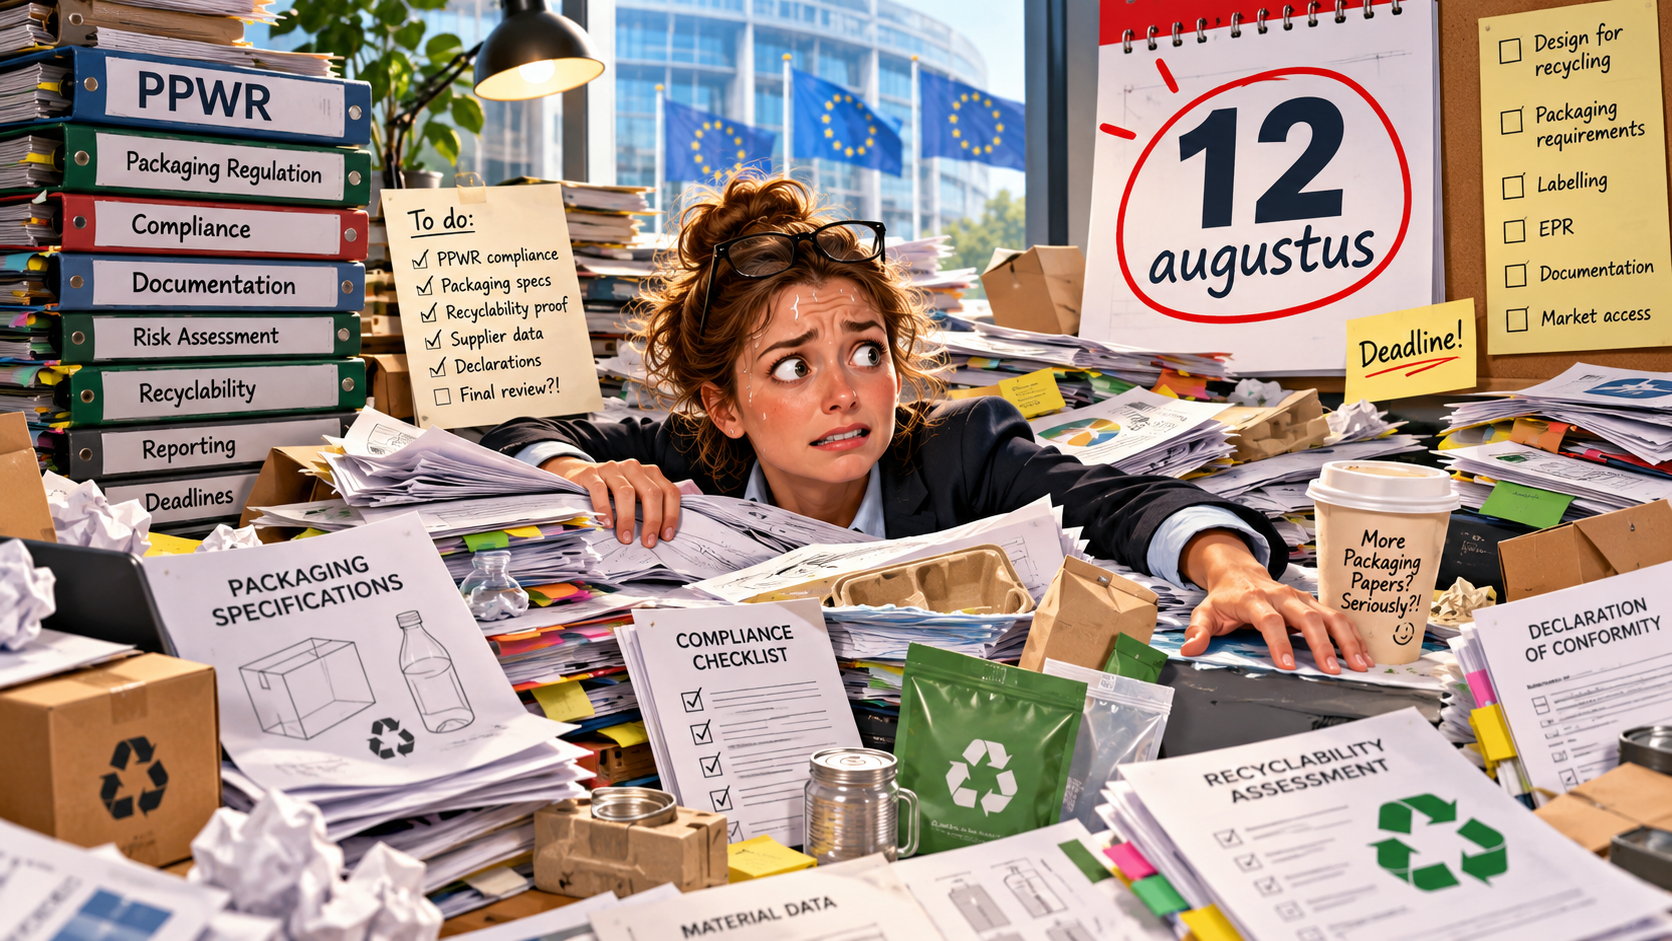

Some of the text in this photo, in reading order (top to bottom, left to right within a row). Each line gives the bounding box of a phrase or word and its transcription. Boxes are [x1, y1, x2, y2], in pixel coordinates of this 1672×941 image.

[1535, 23, 1623, 53] Design for
[1536, 52, 1610, 79] recycling
[139, 71, 271, 121] PPWR
[1536, 101, 1617, 123] Packaging
[1537, 121, 1645, 151] requirements
[127, 151, 321, 185] Packaging Regulation
[1179, 97, 1344, 228] 12
[1538, 171, 1607, 192] Labelling
[132, 214, 250, 243] Compliance
[407, 207, 473, 230] To do:
[1540, 218, 1573, 237] EPR
[438, 248, 558, 267] PPWR compliance
[1149, 225, 1374, 298] augustus
[1541, 259, 1653, 281] Documentation
[133, 272, 295, 294] Documentation
[442, 277, 551, 295] Packaging specs
[446, 296, 568, 323] Recyclability proof
[1542, 308, 1650, 326] Market access
[134, 327, 279, 346] Risk Assessment
[451, 327, 543, 350] Supplier data
[1359, 320, 1462, 367] Deadline!
[455, 356, 541, 374] Declarations
[140, 378, 256, 407] Recyclability
[460, 377, 559, 402] Final review?!
[143, 436, 235, 463] Reporting
[146, 488, 233, 512] Deadlines
[1361, 530, 1405, 549] More
[1344, 548, 1421, 576] Packaging
[228, 555, 370, 597] PACKAGING
[1351, 572, 1414, 597] Papers?
[212, 573, 403, 626] SPECIFICATIONS
[1341, 592, 1421, 619] Seriously?!
[1528, 597, 1648, 640] DECLARATION
[677, 625, 793, 648] COMPLIANCE
[1526, 615, 1661, 662] OF CONFORMITY
[693, 647, 786, 670] CHECKLIST
[1203, 738, 1386, 788] RECYCLABILITY
[1231, 758, 1389, 803] ASSESSMENT
[681, 896, 837, 939] MATERIAL DATA
